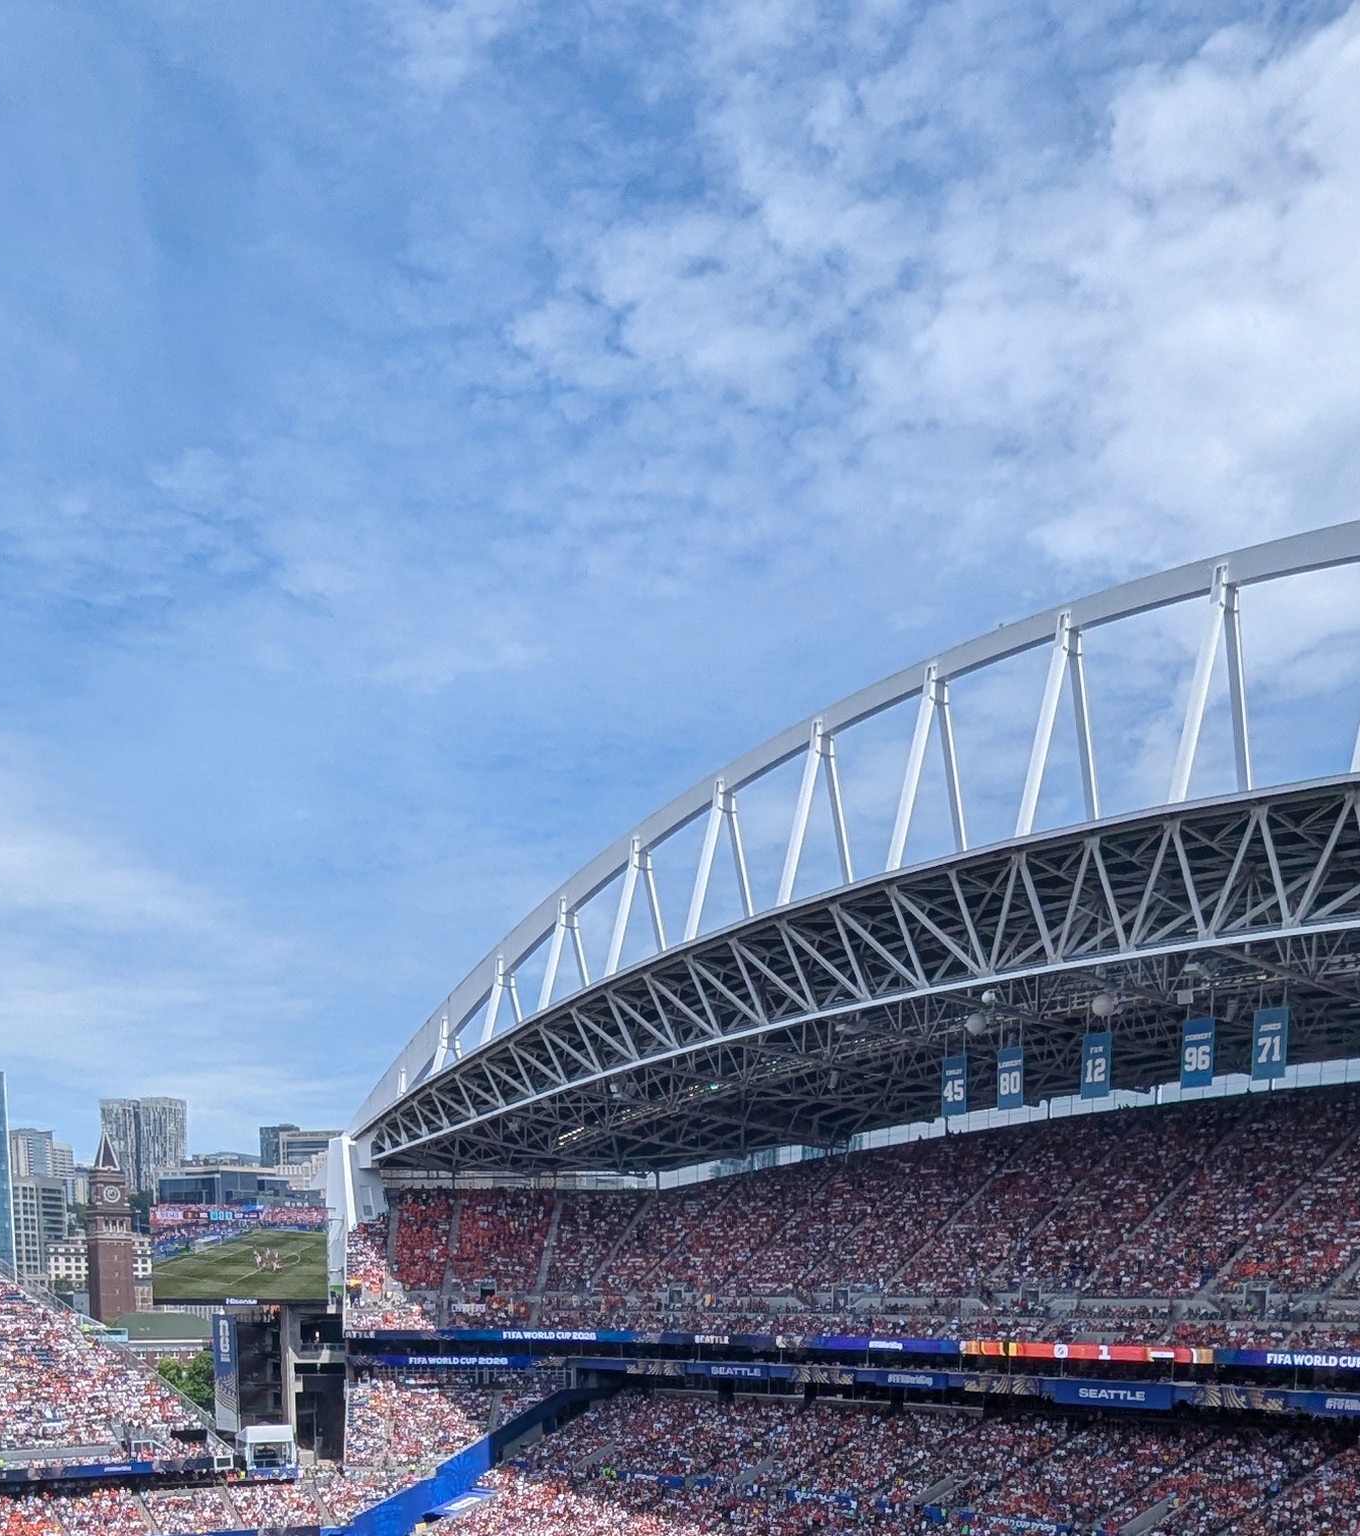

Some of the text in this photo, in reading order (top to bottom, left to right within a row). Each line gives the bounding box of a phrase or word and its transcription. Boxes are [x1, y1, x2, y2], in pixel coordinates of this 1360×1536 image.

[1258, 1035, 1281, 1063] 71
[1184, 1045, 1210, 1072] 96
[1085, 1057, 1107, 1083] 12
[943, 1079, 964, 1102] 45
[1000, 1071, 1021, 1096] 80
[523, 1331, 555, 1340] WORLD
[694, 1335, 730, 1344] SEATTLE
[1098, 1345, 1111, 1360] 1
[409, 1356, 509, 1366] FIFA WORLD CUP 2026
[1266, 1353, 1291, 1366] FIFA
[1293, 1354, 1338, 1367] WORLD
[710, 1366, 761, 1377] SEATTLE
[1078, 1387, 1146, 1401] SEATTLE
